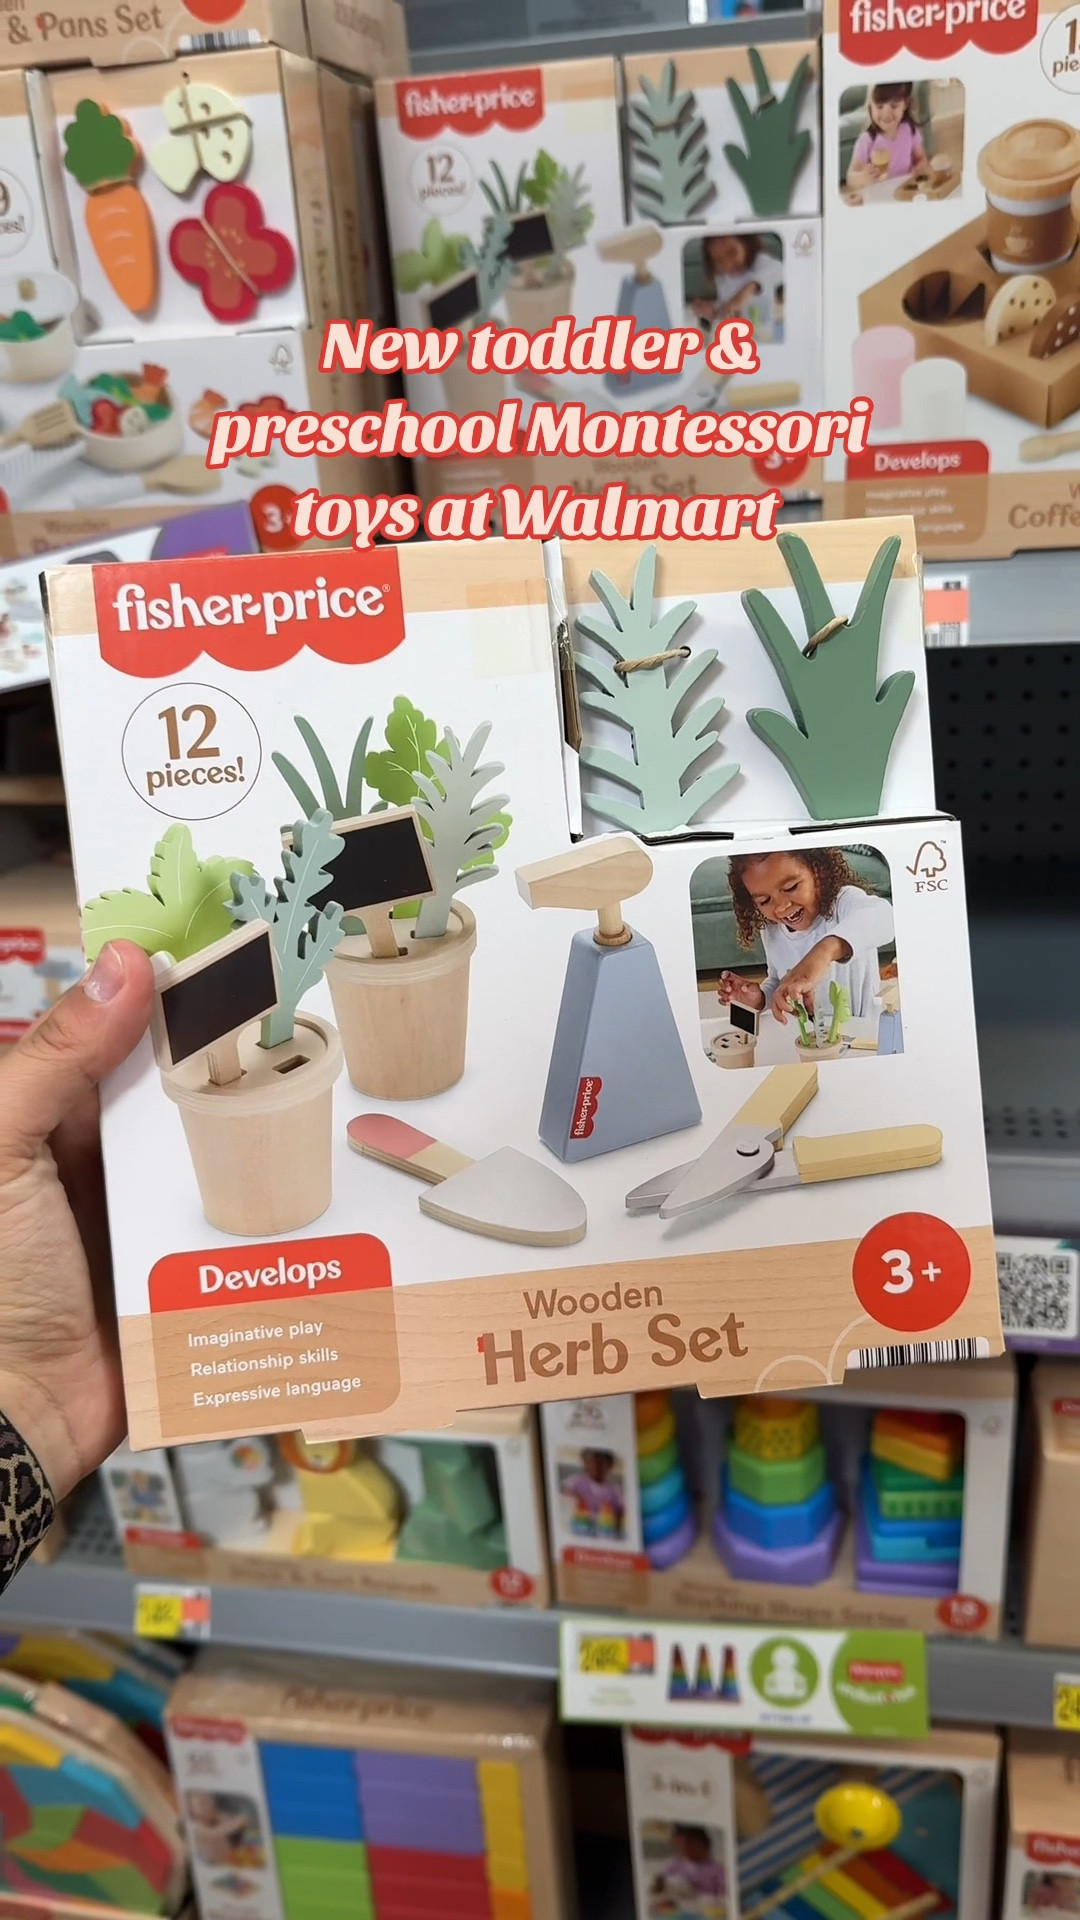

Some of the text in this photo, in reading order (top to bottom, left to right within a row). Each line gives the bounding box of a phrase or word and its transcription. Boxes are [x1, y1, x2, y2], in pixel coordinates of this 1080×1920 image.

[8, 4, 163, 45] & Pans Set
[404, 83, 536, 119] fisher-price
[426, 154, 455, 184] 12
[874, 449, 961, 474] Develops
[157, 703, 221, 760] 12
[145, 756, 245, 796] pieces!
[914, 879, 948, 893] FSC
[199, 1257, 342, 1294] Develops
[881, 1248, 942, 1294] 3+
[523, 1282, 662, 1319] Wooden
[188, 1321, 323, 1348] Imaginative play
[483, 1311, 749, 1386] Herb Set
[191, 1348, 338, 1377] Relationship skills
[193, 1376, 361, 1408] Expressive language
